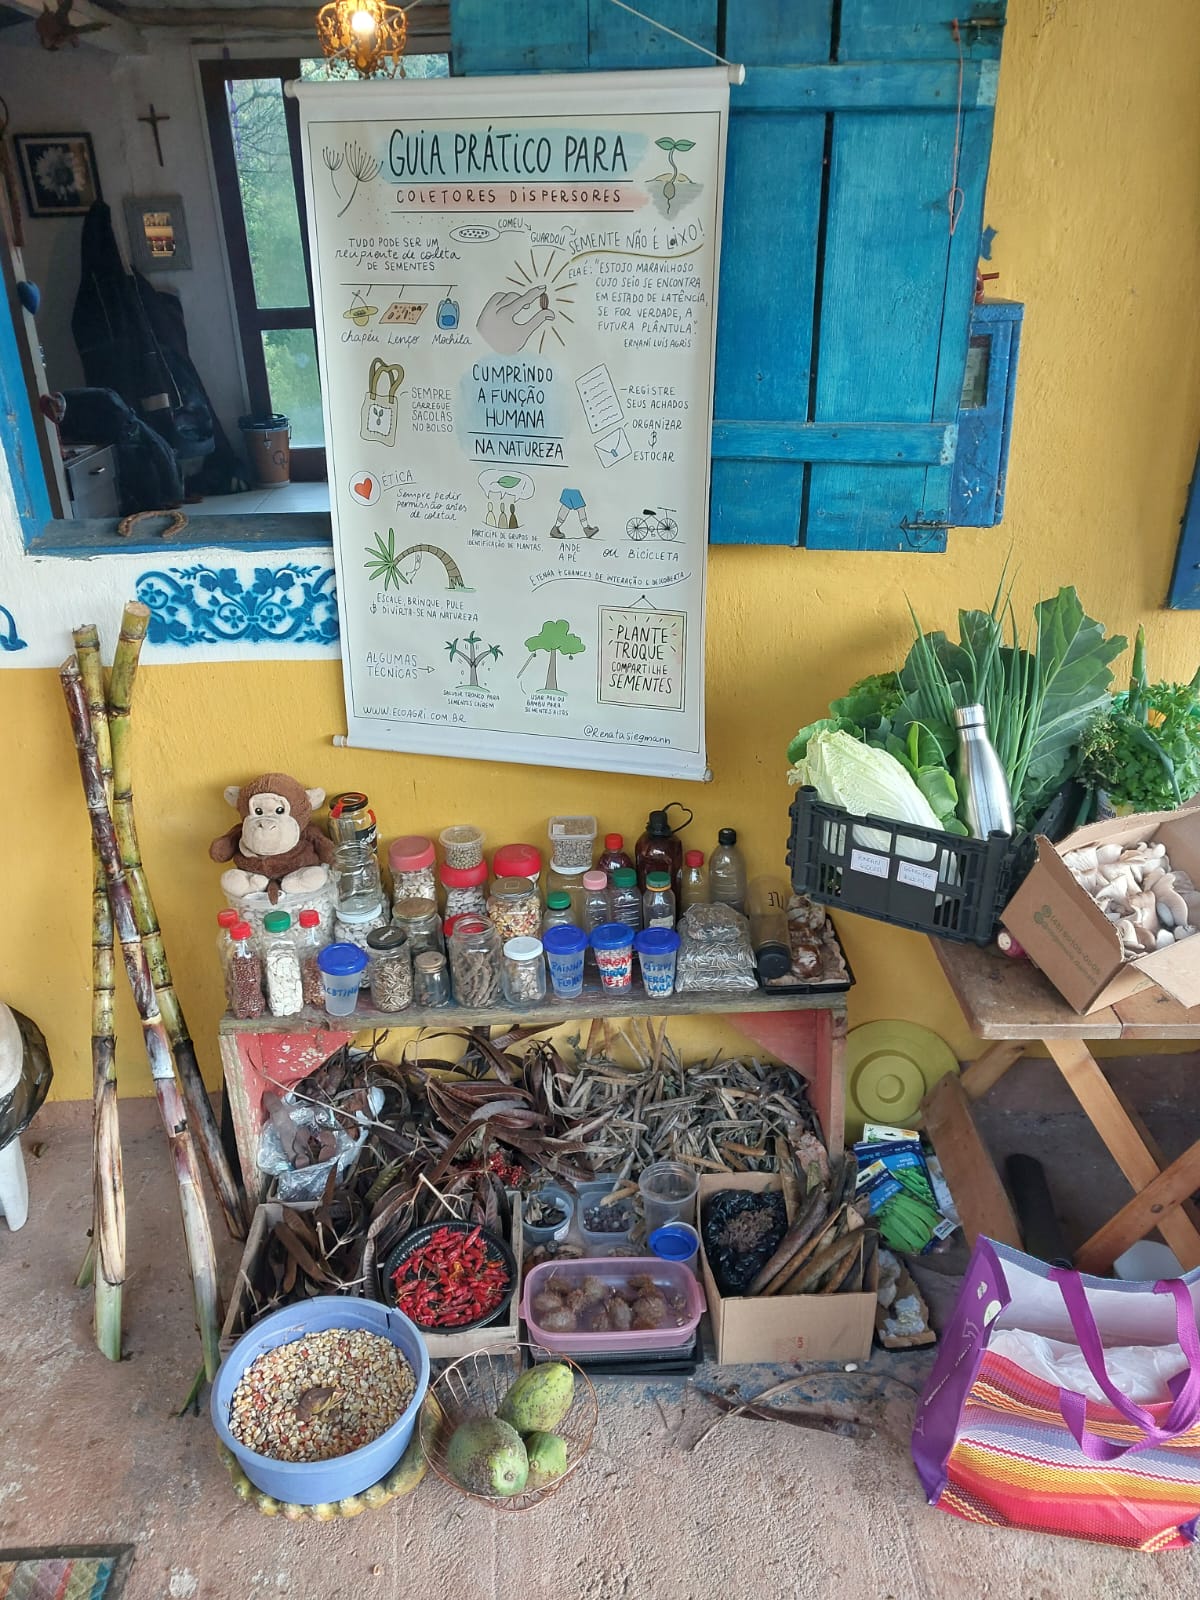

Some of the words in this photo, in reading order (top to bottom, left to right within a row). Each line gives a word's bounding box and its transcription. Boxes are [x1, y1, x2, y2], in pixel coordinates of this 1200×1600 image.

[389, 128, 446, 176] GUIA
[455, 126, 551, 174] PRÁTICO
[565, 135, 628, 174] PARA
[397, 189, 496, 204] COLETORES
[510, 186, 620, 203] DISPERSORES
[497, 218, 524, 229] COMEU
[348, 238, 375, 248] TUDO
[378, 237, 400, 248] PODE
[403, 237, 421, 248] SER
[426, 238, 439, 248] UM
[530, 231, 566, 246] GUARDOU
[569, 231, 620, 255] SEMENTE
[626, 227, 648, 249] NÃO
[653, 226, 660, 250] É
[335, 249, 398, 267] recipiente
[401, 249, 415, 260] de
[420, 246, 461, 260] coleta
[367, 261, 378, 271] DE
[384, 261, 435, 271] SEMENTES
[568, 268, 581, 279] ELA
[595, 277, 618, 288] CUJO
[643, 277, 653, 289] SE
[656, 277, 701, 288] ENCONTRA
[595, 292, 609, 302] EM
[612, 291, 644, 303] ESTADO
[647, 292, 657, 302] DE
[598, 305, 608, 316] SE
[614, 306, 632, 316] FOR
[637, 307, 681, 321] VERDADE,
[685, 308, 693, 318] A
[598, 320, 634, 332] FUTURA
[340, 329, 380, 345] Chapéu
[387, 330, 420, 348] Lenço
[431, 332, 473, 345] Mochila
[472, 363, 553, 384] CUMPRINDO
[411, 386, 451, 400] SEMPRE
[477, 387, 486, 404] A
[491, 385, 545, 407] FUNÇÃO
[412, 401, 451, 410] CARREGUE
[626, 398, 647, 409] SEUS
[650, 399, 689, 410] ACHADOS
[411, 410, 453, 422] SACOLAS
[485, 407, 545, 429] HUMANA
[412, 423, 424, 432] NO
[426, 423, 453, 433] BOLSO
[632, 417, 683, 430] ORGANIZAR
[475, 438, 495, 455] NA
[498, 440, 564, 460] NATUREZA
[633, 451, 675, 462] ESTOCAR
[396, 489, 431, 501] Sempre
[434, 489, 462, 501] pedir
[396, 500, 443, 512] permissão
[445, 500, 468, 512] antes
[409, 511, 421, 519] de
[424, 511, 457, 521] coletar
[559, 542, 581, 552] ANDE
[558, 552, 565, 562] A
[567, 551, 577, 562] PÉ
[446, 599, 465, 610] PULE
[426, 608, 437, 618] NA
[439, 611, 479, 622] NATUREZA
[616, 624, 669, 644] PLANTE
[614, 641, 664, 660] TROQUE
[366, 651, 418, 667] ALGUMAS
[367, 663, 418, 680] TÉCNICAS
[611, 661, 668, 675] COMPARTILHE
[609, 673, 673, 694] SEMENTES
